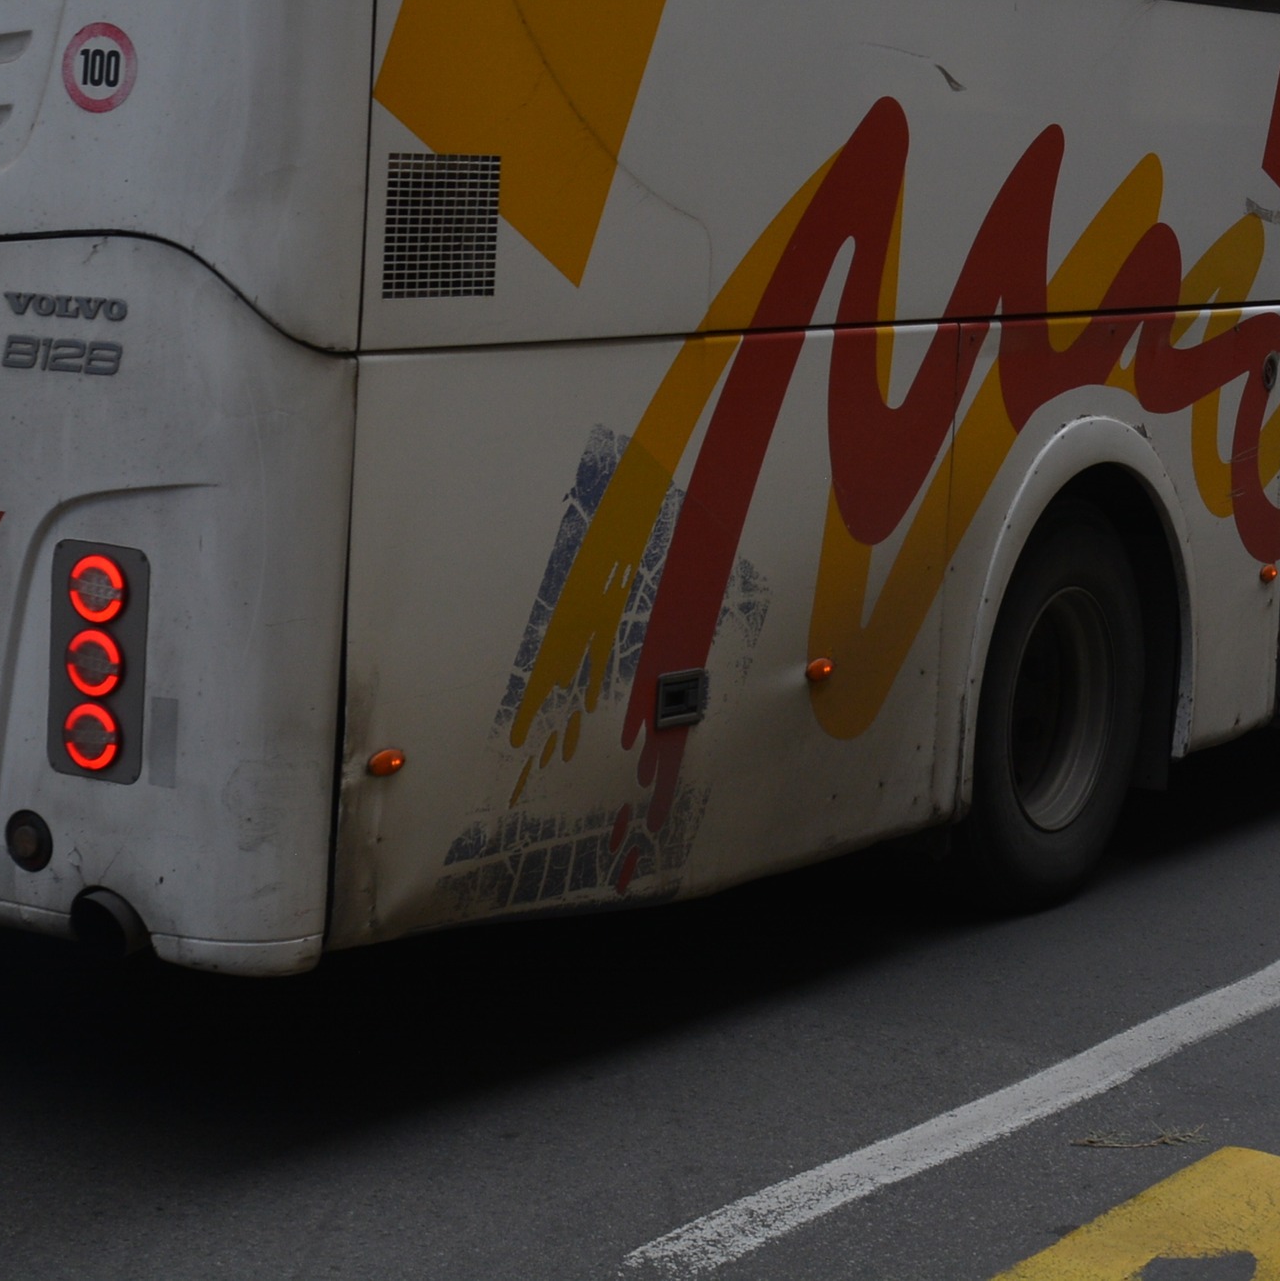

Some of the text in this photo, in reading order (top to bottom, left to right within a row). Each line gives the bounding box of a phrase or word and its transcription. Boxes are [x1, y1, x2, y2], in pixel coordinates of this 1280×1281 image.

[80, 48, 121, 88] 100
[3, 291, 128, 321] VOLVO
[2, 335, 123, 376] B12B
